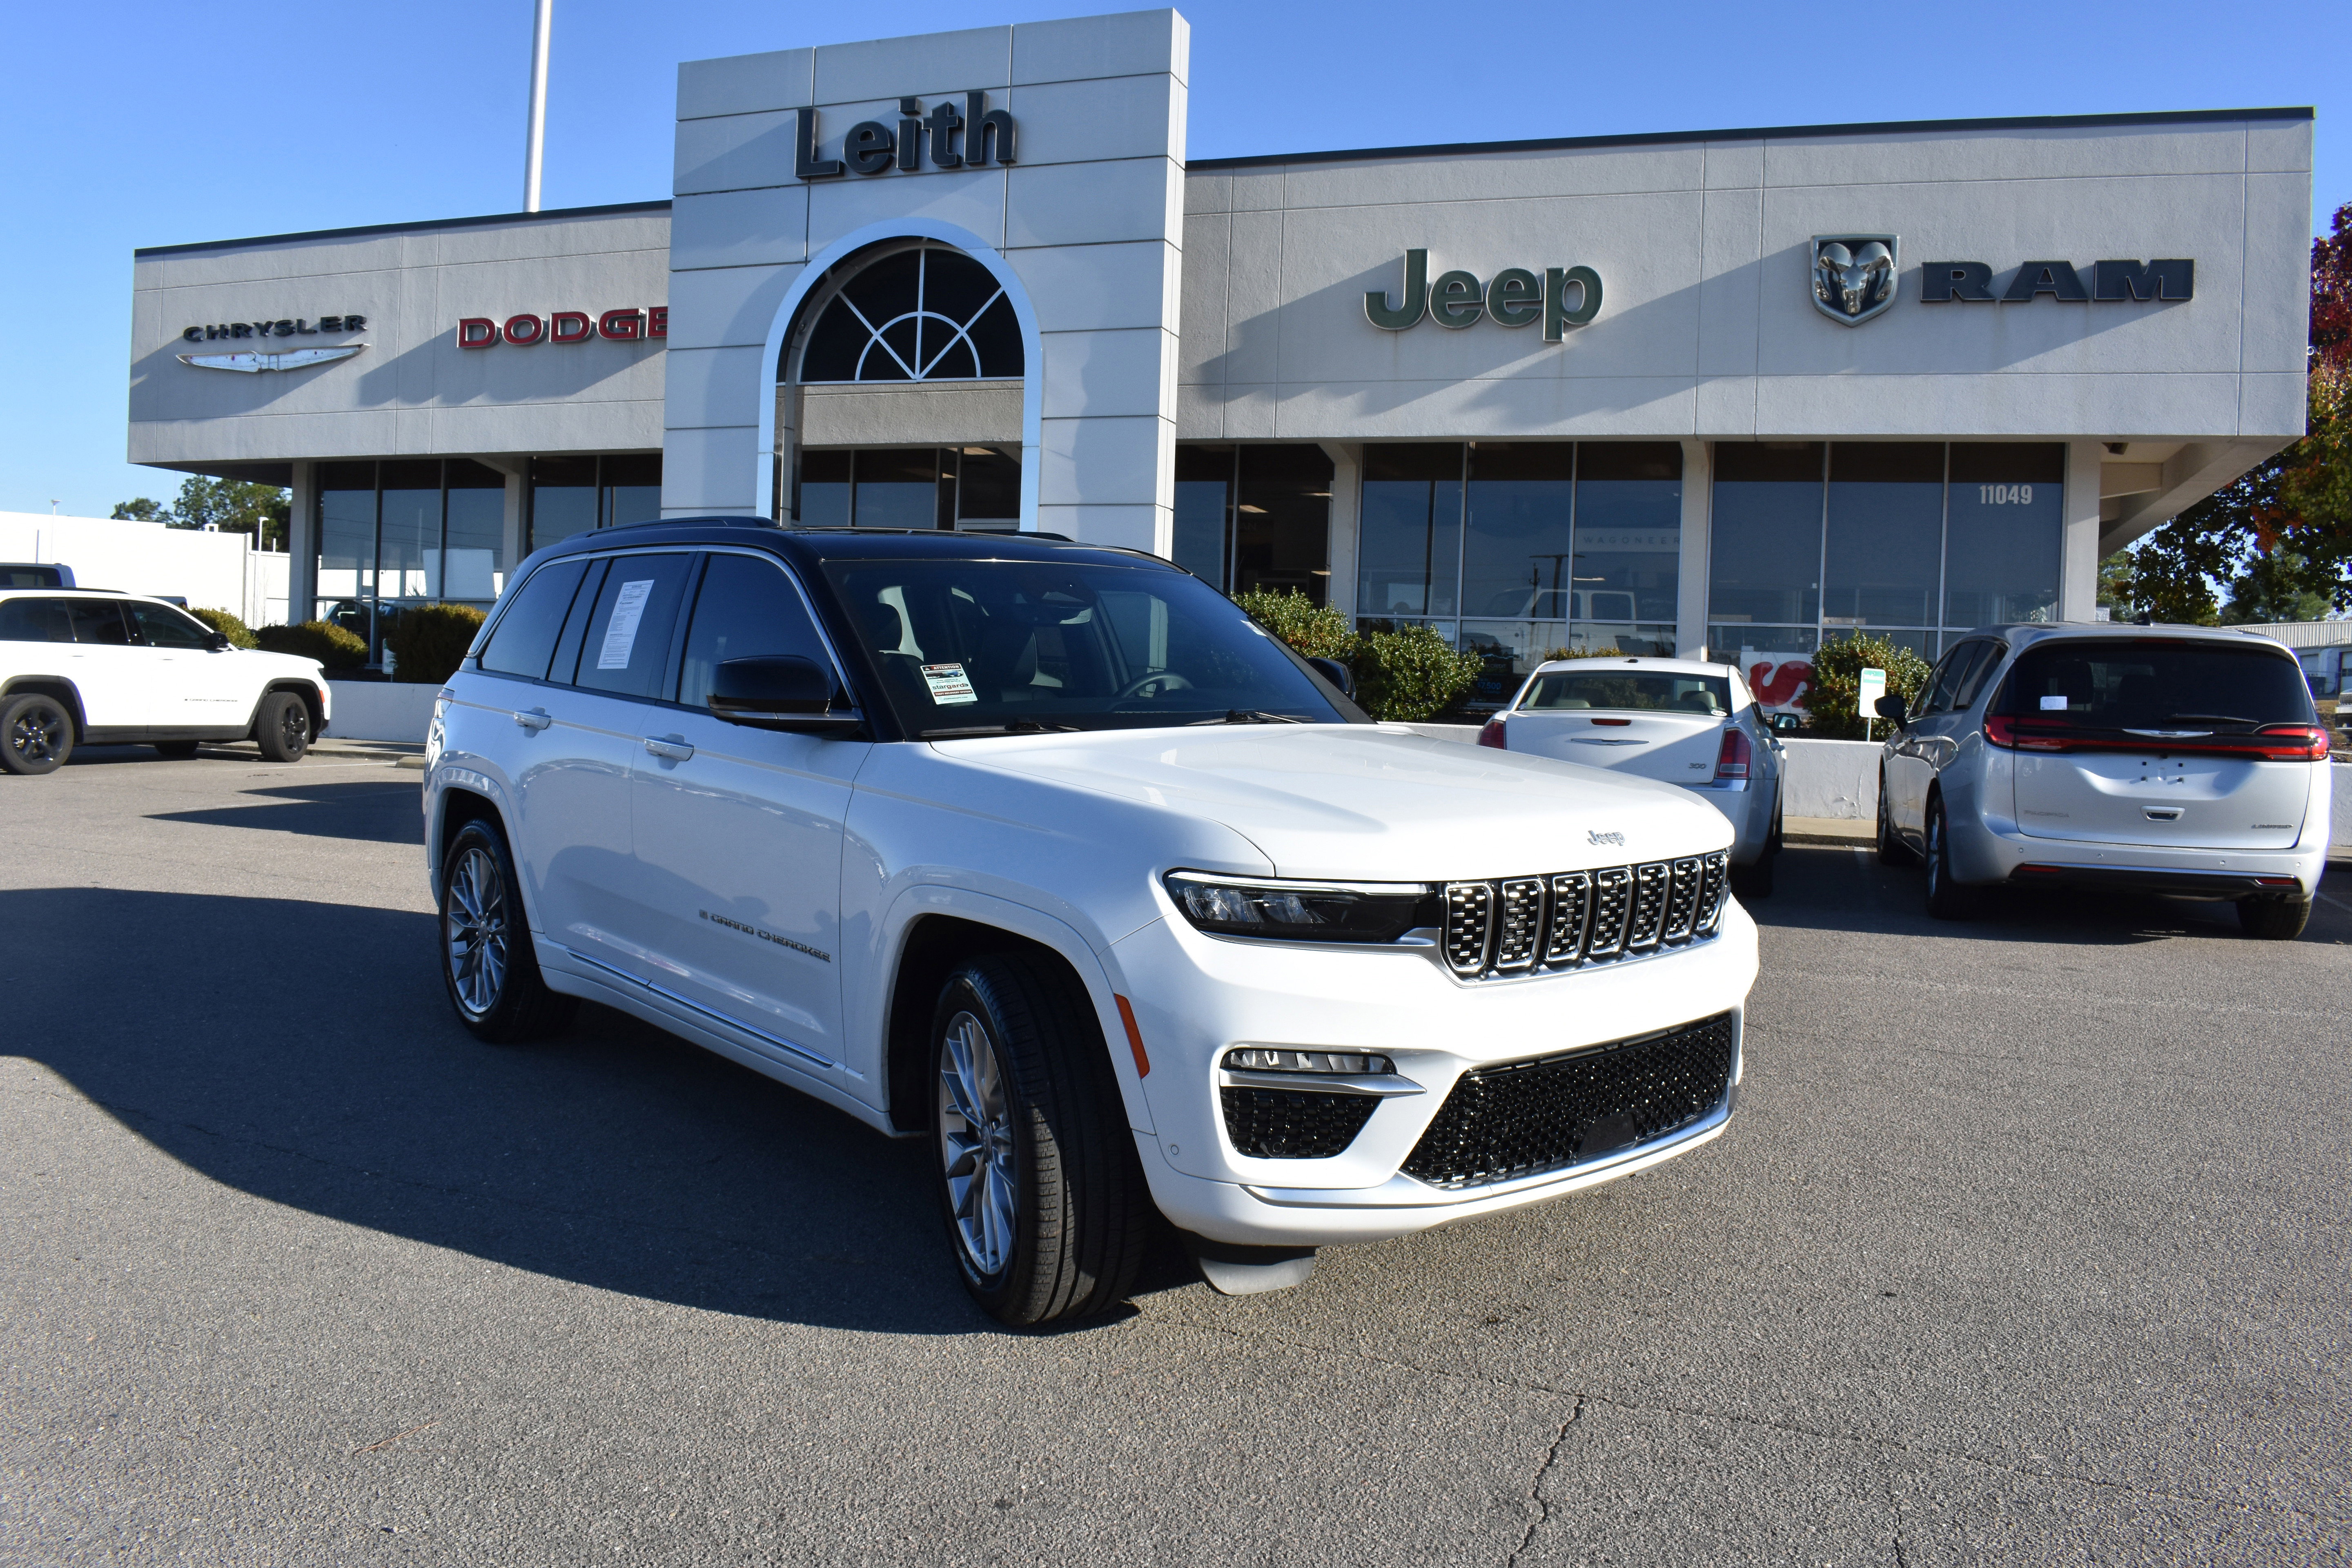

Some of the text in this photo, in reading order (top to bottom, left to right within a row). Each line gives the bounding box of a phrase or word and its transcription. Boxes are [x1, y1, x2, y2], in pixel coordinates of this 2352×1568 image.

[794, 91, 1017, 179] Leith
[1364, 248, 1604, 342] Jeep
[1920, 259, 2195, 302] RAM
[183, 315, 367, 342] CHRYSLER
[457, 306, 668, 348] DODGE
[1980, 485, 2032, 504] 11049
[1587, 830, 1625, 846] Jeep
[710, 913, 831, 962] GRAND CHEROKEE
